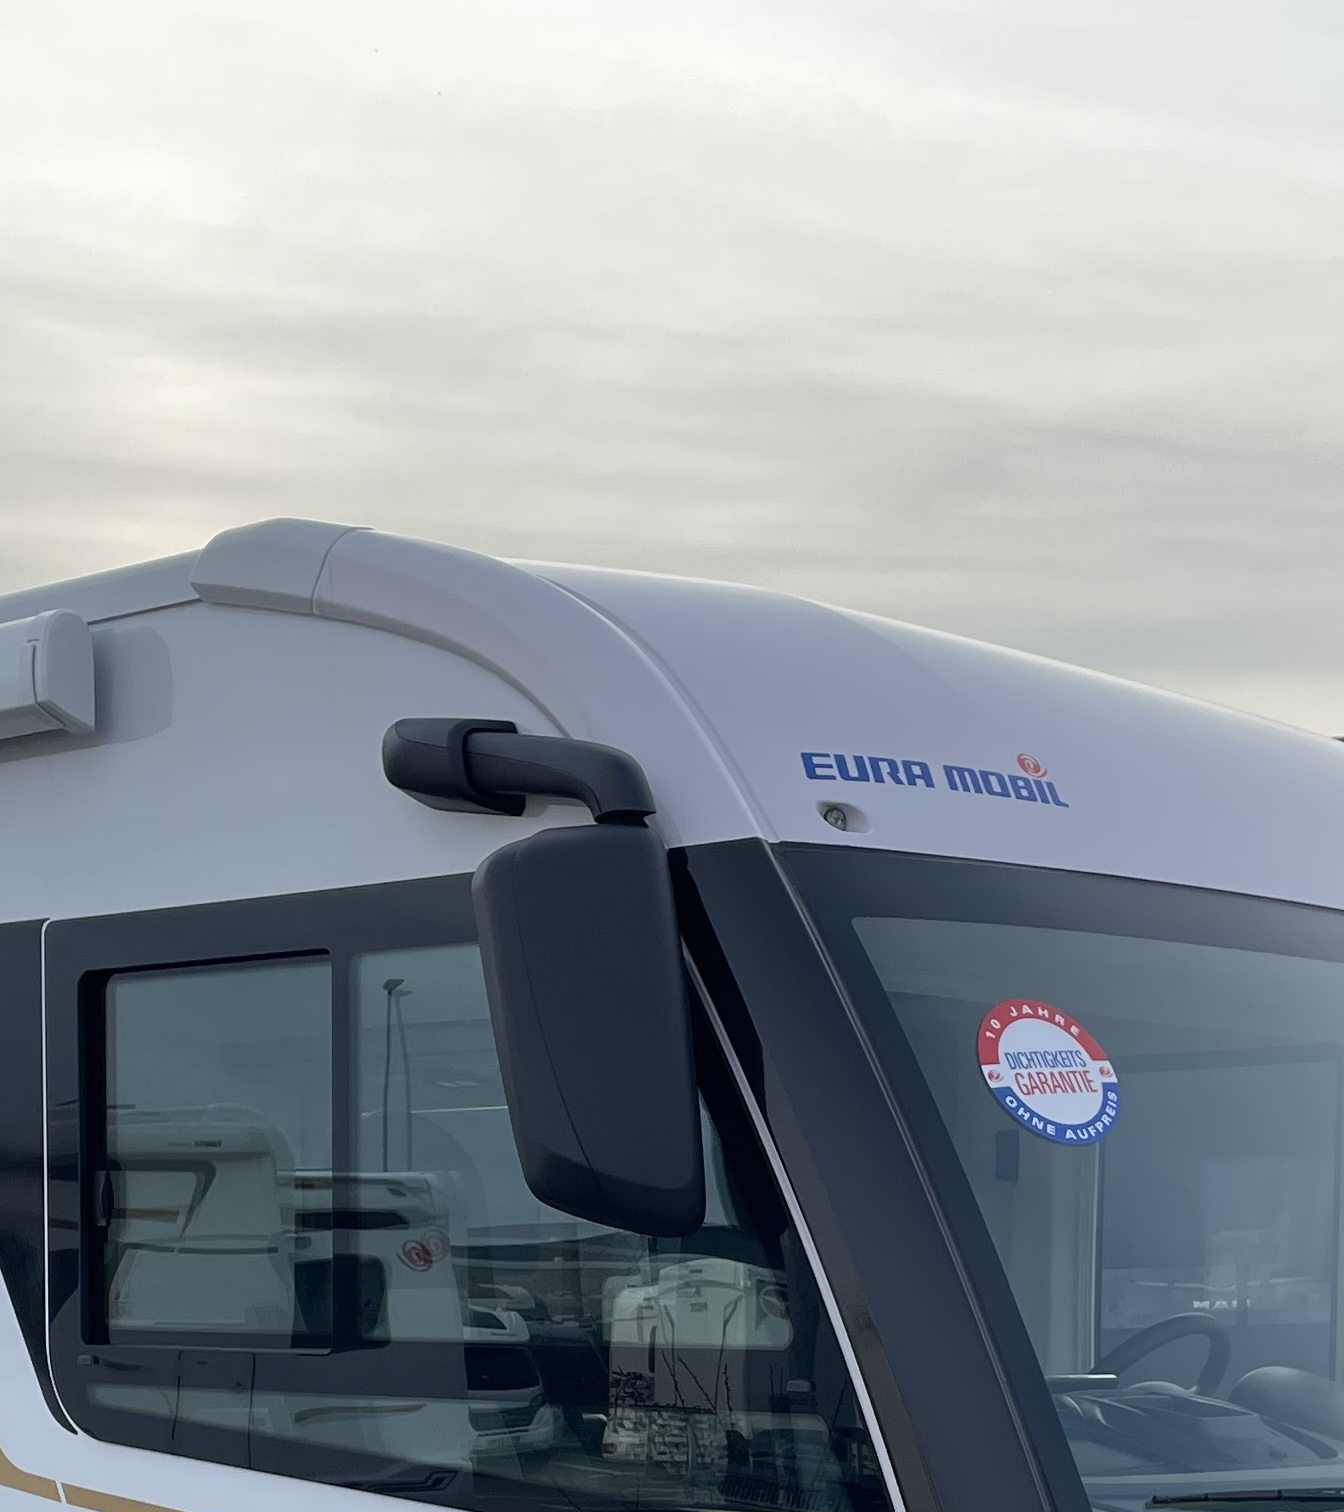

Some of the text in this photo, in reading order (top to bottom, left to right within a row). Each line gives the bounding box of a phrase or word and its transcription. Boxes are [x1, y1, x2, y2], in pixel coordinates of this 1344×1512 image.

[800, 752, 1070, 808] EURA MOBIL
[986, 1004, 1080, 1039] 10 JAHRE
[1004, 1049, 1087, 1070] DICHTIGKEITS
[1014, 1070, 1099, 1096] GARANTIE
[1005, 1090, 1118, 1140] OHNE AUFPREIS
